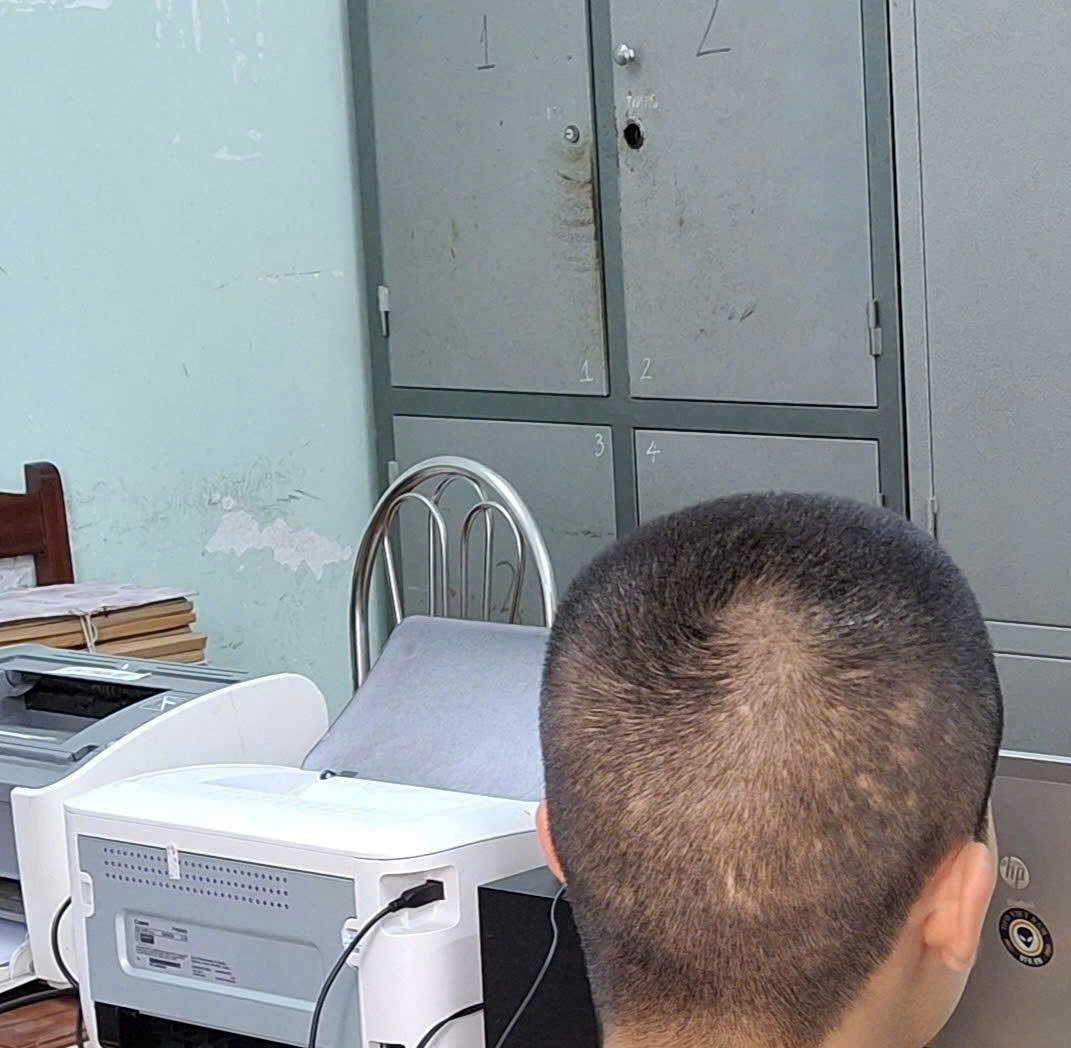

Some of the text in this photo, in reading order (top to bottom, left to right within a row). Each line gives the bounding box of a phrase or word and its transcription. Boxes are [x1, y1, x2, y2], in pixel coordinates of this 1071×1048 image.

[579, 359, 594, 382] 1
[640, 358, 653, 380] 2
[594, 432, 606, 457] 3
[646, 440, 661, 464] 4
[1001, 856, 1029, 889] hp
